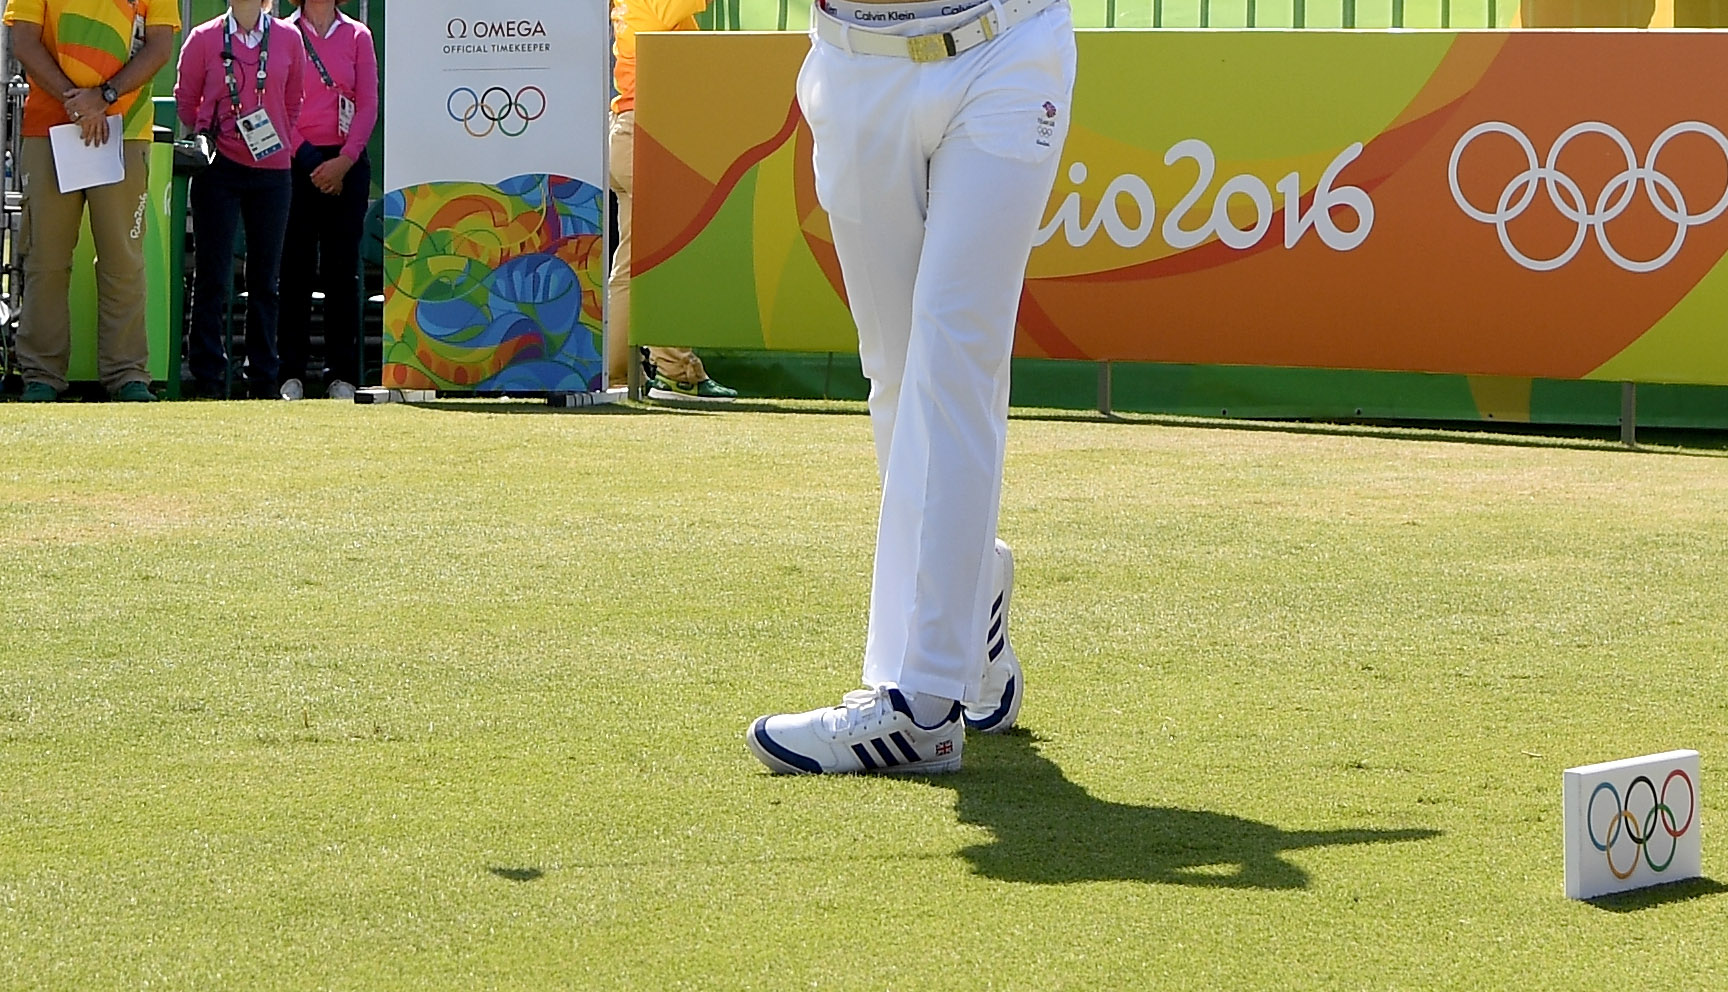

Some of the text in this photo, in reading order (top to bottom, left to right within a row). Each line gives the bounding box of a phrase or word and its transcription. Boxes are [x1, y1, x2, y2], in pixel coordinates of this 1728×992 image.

[854, 9, 915, 21] Calvin Klein
[473, 20, 546, 39] OMEGA
[442, 43, 550, 54] OFFICIAL TIMEKEEPER
[1031, 139, 1375, 251] io2016
